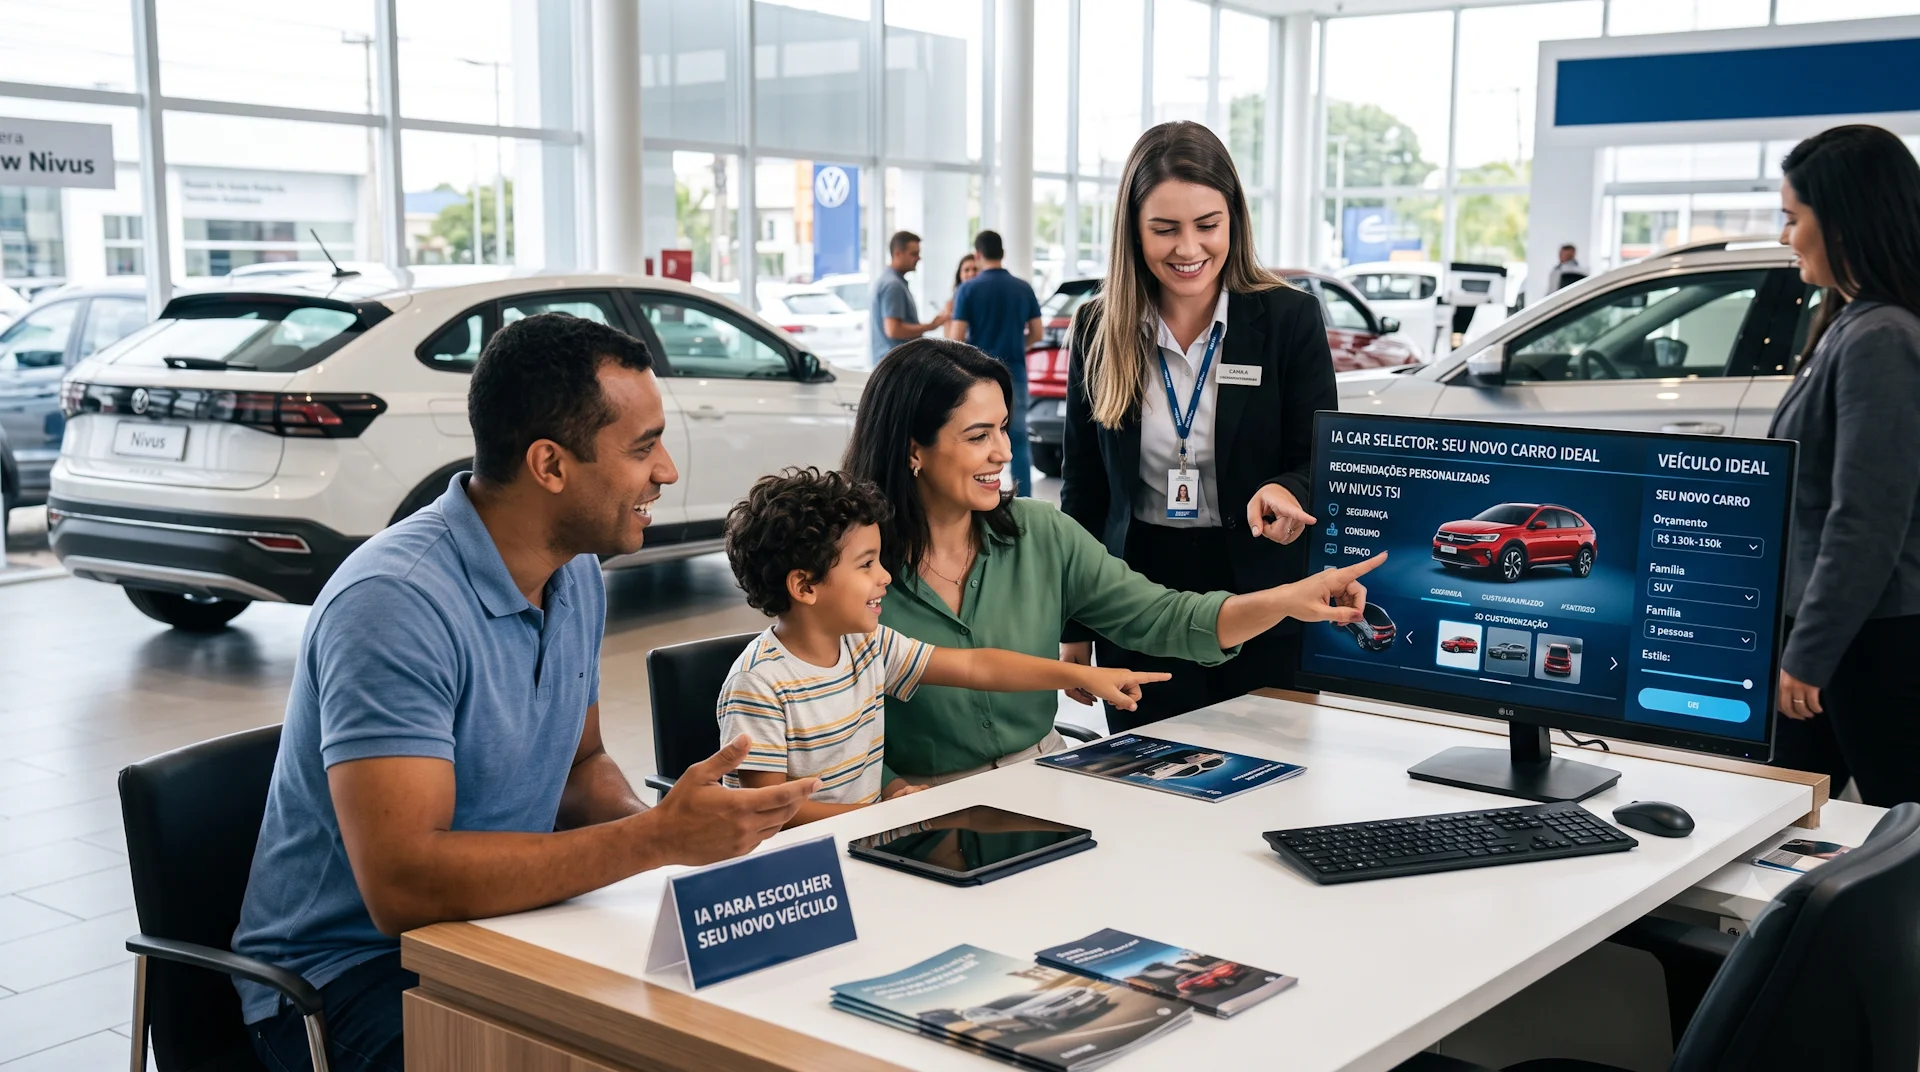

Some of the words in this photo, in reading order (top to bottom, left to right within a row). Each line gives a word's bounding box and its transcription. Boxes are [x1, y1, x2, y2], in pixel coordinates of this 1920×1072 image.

[29, 150, 95, 174] Nivus
[131, 431, 165, 449] Nivus
[1331, 430, 1344, 444] IA
[1346, 431, 1371, 446] CAR
[1373, 433, 1439, 451] SELECTOR:
[1441, 438, 1467, 453] SEU
[1469, 440, 1508, 456] NOVO
[1510, 443, 1557, 460] CARRO
[1560, 446, 1600, 463] IDEAL
[1658, 451, 1722, 472] VEÍCULO
[1725, 458, 1770, 476] IDEAL
[1329, 461, 1408, 478] RECOMENDAÇÕES
[1409, 467, 1491, 484] PERSONALIZADAS
[1328, 480, 1347, 494] VW
[1349, 482, 1383, 498] NIVUS
[1384, 485, 1401, 499] TSI
[1655, 488, 1676, 501] SEU
[1678, 491, 1710, 504] NOVO
[1712, 494, 1751, 508] CARRO
[1345, 507, 1389, 521] SEGURANÇA
[1653, 513, 1708, 528] Orçamento
[1344, 526, 1380, 538] CONSUMO
[1657, 533, 1670, 545] R$
[1671, 534, 1722, 549] 130k-150k
[1343, 545, 1371, 558] ESPAÇO
[1649, 562, 1685, 576] Família
[1653, 582, 1674, 593] SUV
[1645, 604, 1681, 618] Família
[1649, 624, 1656, 634] 3
[1657, 625, 1694, 639] pessoas
[694, 907, 713, 926] IA
[713, 895, 756, 921] PARA
[757, 873, 833, 908] ESCOLHER
[697, 925, 729, 949] SEU
[730, 912, 775, 940] NOVO
[776, 894, 838, 925] VEÍCULO
